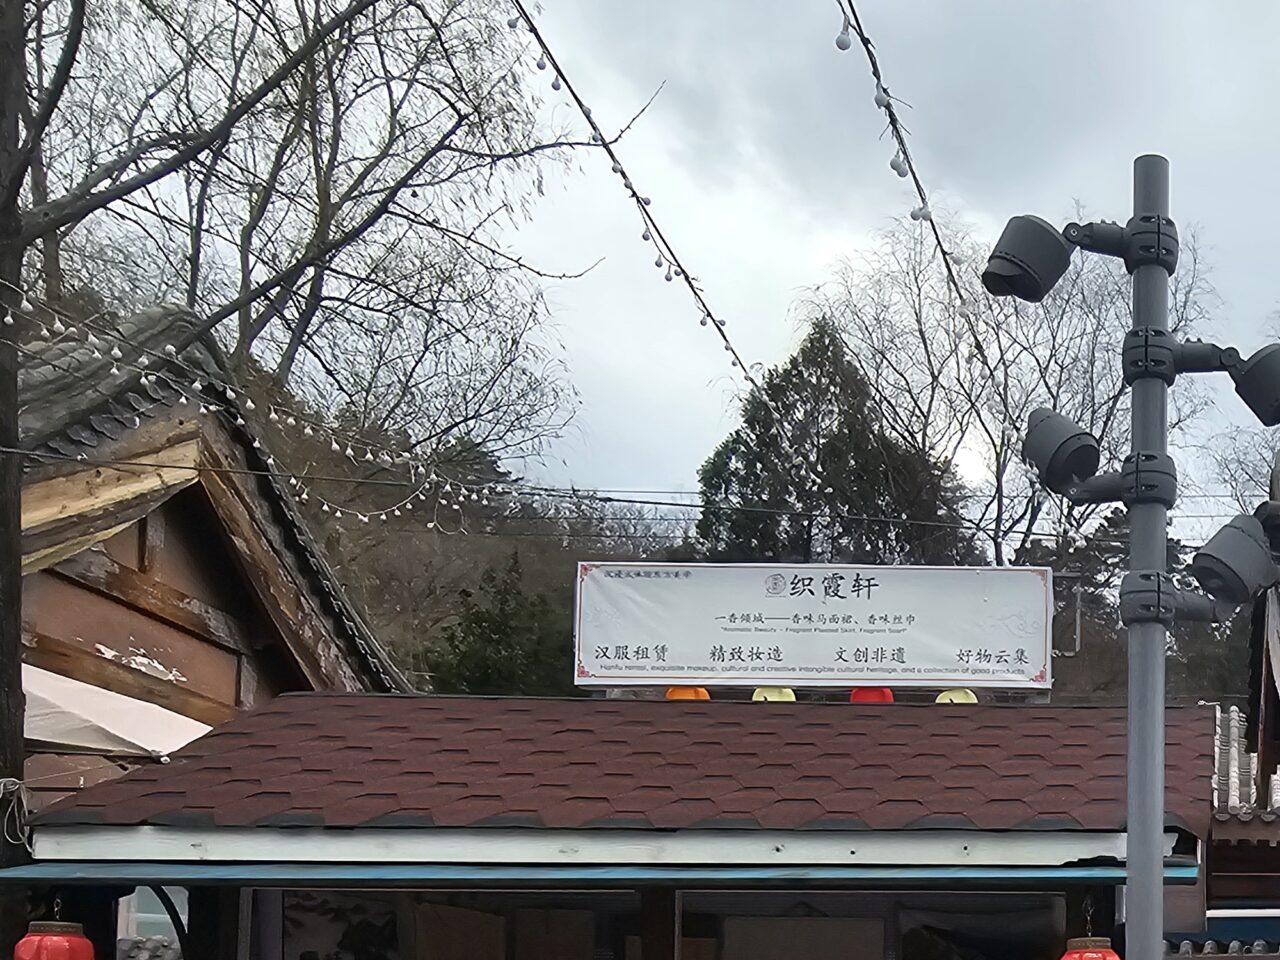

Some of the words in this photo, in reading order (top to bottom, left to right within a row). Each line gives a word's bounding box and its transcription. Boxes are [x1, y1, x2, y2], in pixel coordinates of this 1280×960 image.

[789, 573, 880, 600] 织霞轩
[595, 644, 669, 662] 汉服租赁
[709, 645, 784, 663] 精致妆造
[834, 647, 907, 664] 文创非遗
[956, 648, 1030, 665] 好物云集
